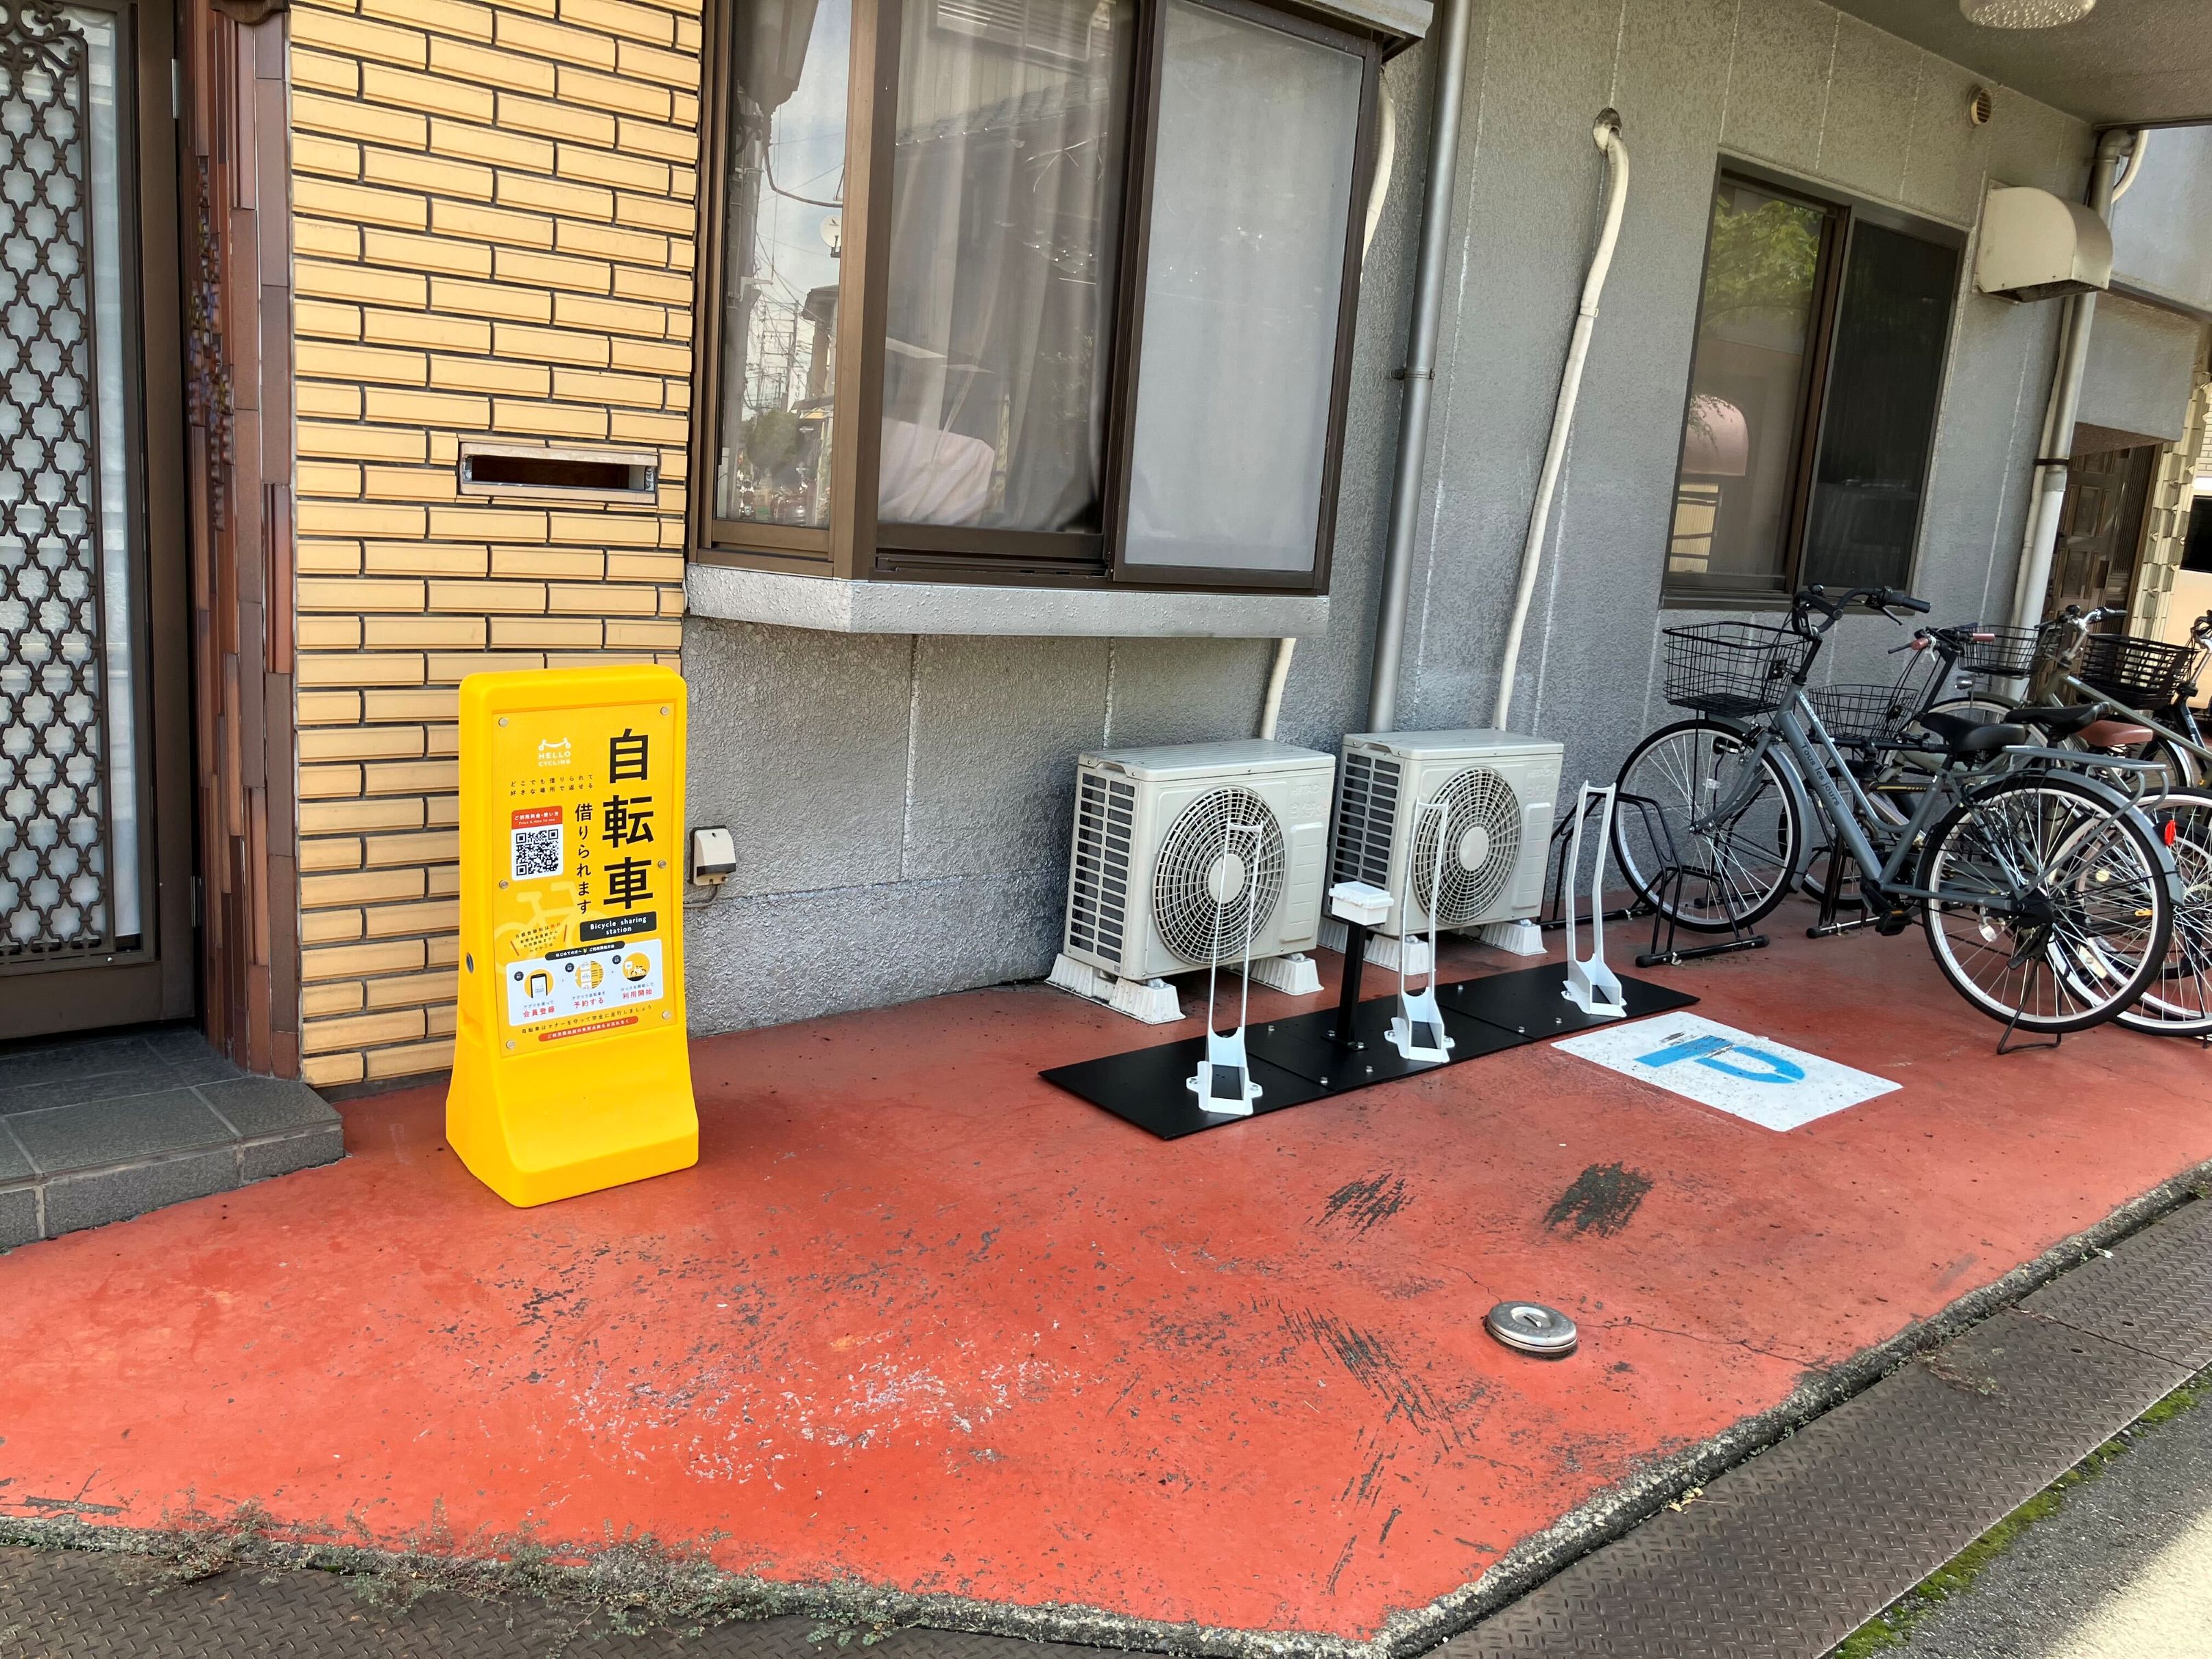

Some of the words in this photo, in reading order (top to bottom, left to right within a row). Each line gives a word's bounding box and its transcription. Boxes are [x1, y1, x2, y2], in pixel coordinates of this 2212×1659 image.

[538, 751, 570, 760] HELLO
[1801, 742, 1816, 766] Tous
[1815, 766, 1825, 781] les
[1821, 782, 1840, 806] jours
[511, 774, 593, 787] どこでも借りられて
[510, 784, 593, 796] 好きな場所で返せる
[602, 728, 654, 909] 自転車
[575, 803, 593, 915] 借りられます
[590, 921, 616, 930] Bicycle
[621, 917, 647, 927] sharing
[605, 925, 632, 936] station
[622, 988, 653, 1000] 利用開始
[573, 997, 604, 1008] 予約する
[523, 1006, 555, 1018] 会員登録
